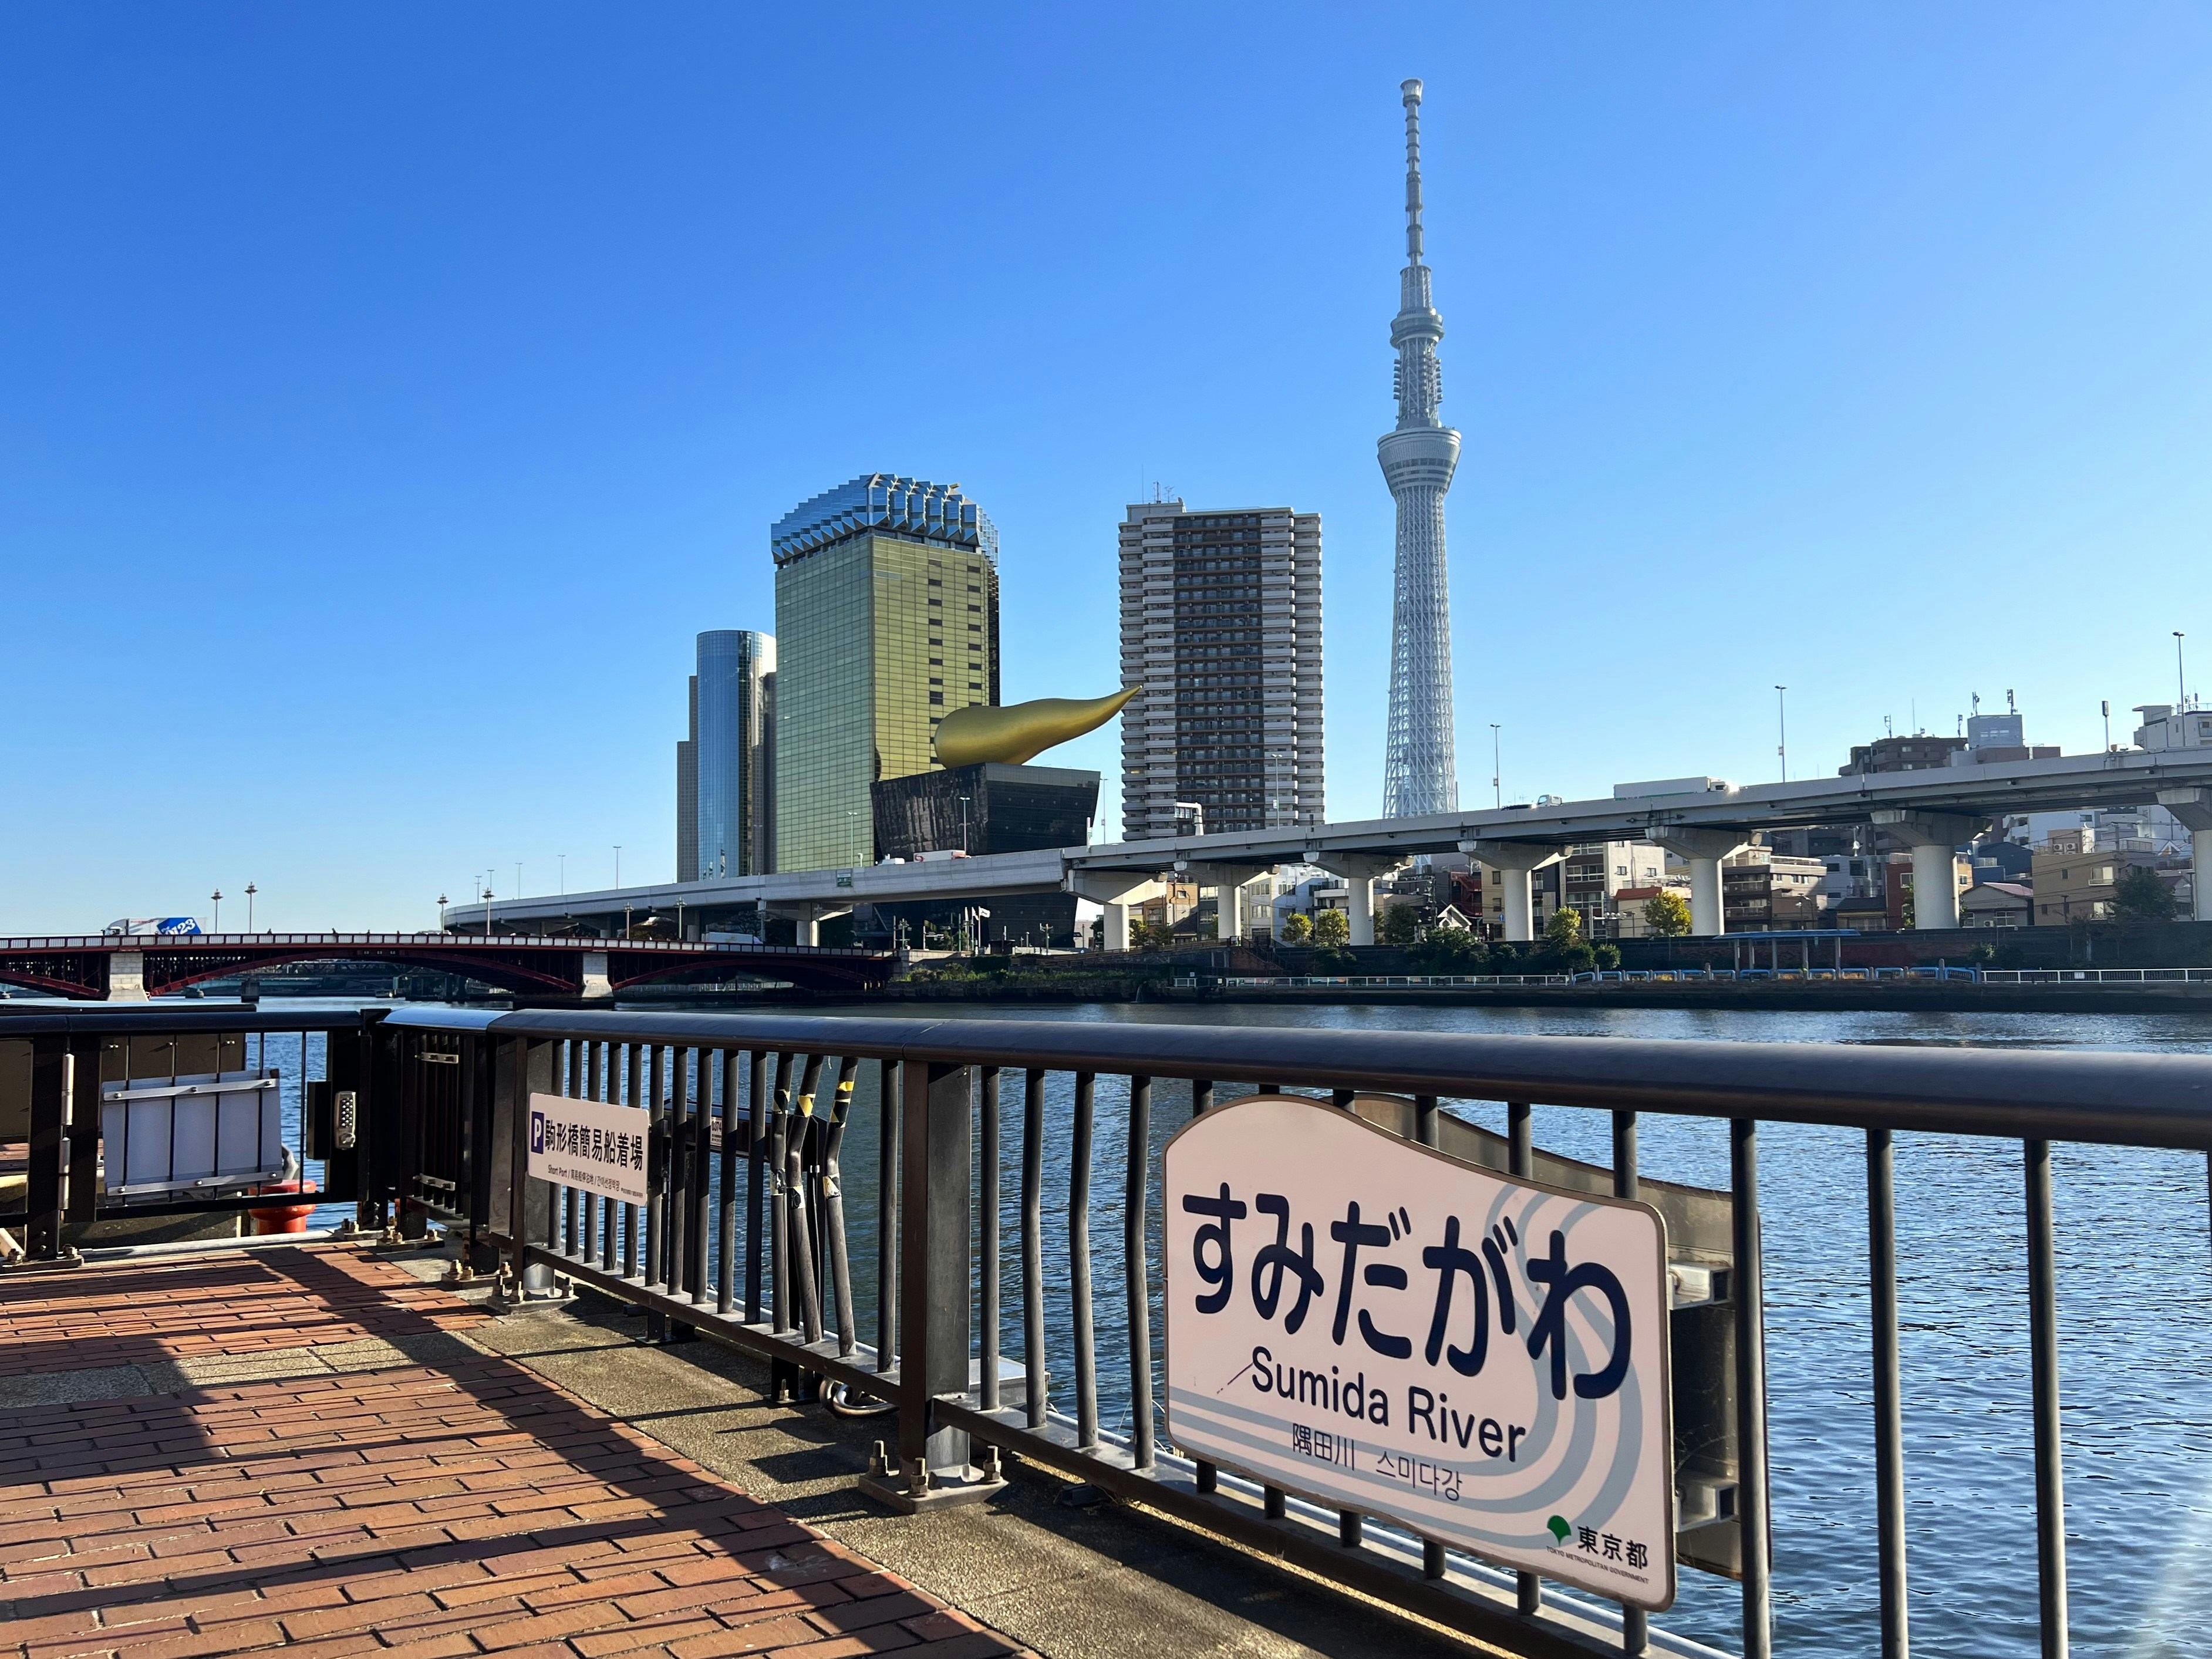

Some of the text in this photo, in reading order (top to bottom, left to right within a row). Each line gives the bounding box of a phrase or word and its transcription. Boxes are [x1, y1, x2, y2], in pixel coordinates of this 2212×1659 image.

[534, 1118, 542, 1147] P
[545, 1120, 643, 1171] 駒形橋簡易船着場
[1182, 1182, 1632, 1400] すみだがわ
[1252, 1346, 1526, 1462] Sumida River
[1292, 1423, 1355, 1471] 隅田川
[1375, 1451, 1463, 1502] 스미다강
[1546, 1545, 1650, 1584] TOKYO METROPOLITAN GOVERNMENT
[1577, 1526, 1648, 1570] 東京都
